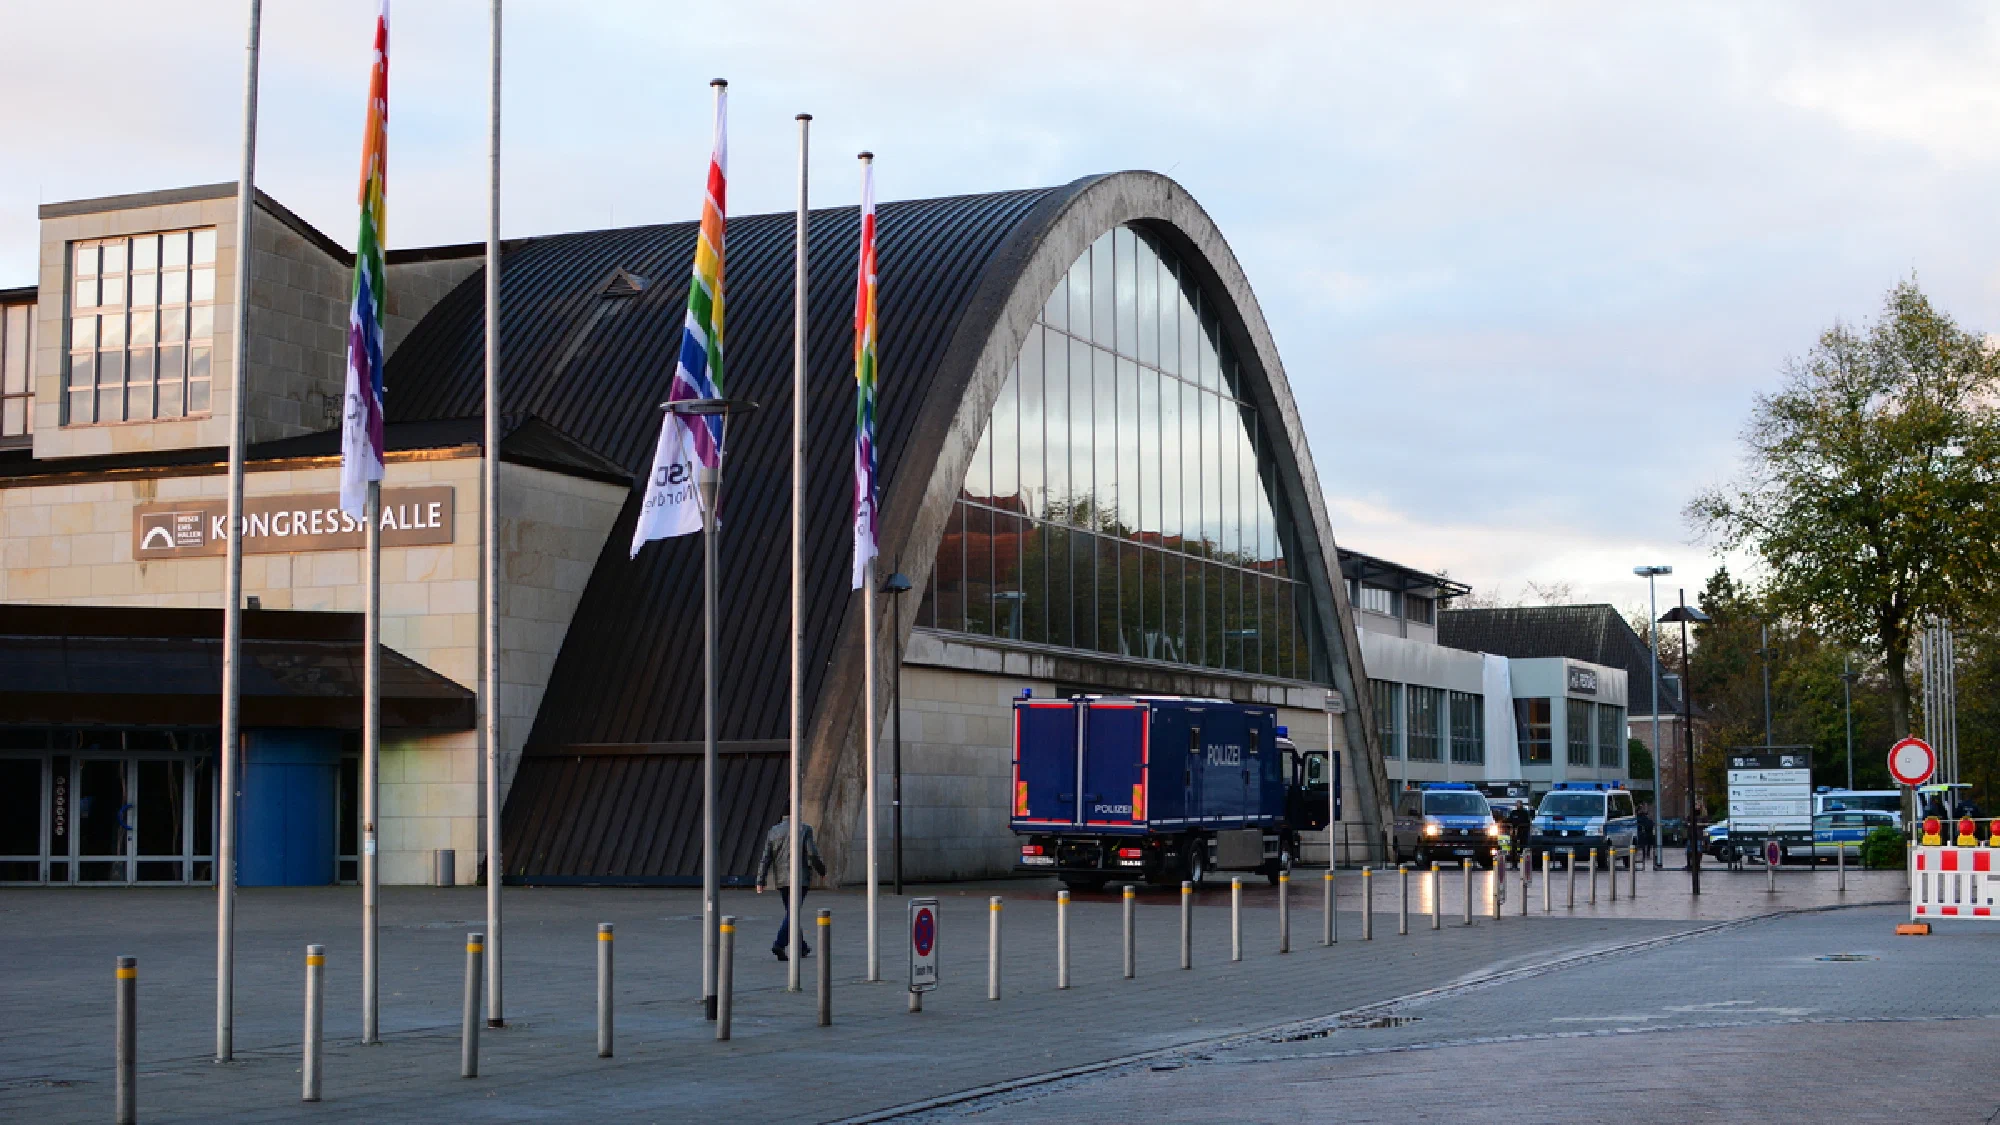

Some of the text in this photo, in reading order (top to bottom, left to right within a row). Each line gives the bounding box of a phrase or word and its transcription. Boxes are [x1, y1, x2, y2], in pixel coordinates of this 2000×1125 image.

[211, 501, 442, 540] KNGRESSALLE
[1207, 743, 1241, 767] POLIZEI
[1094, 804, 1133, 814] POLIZEI
